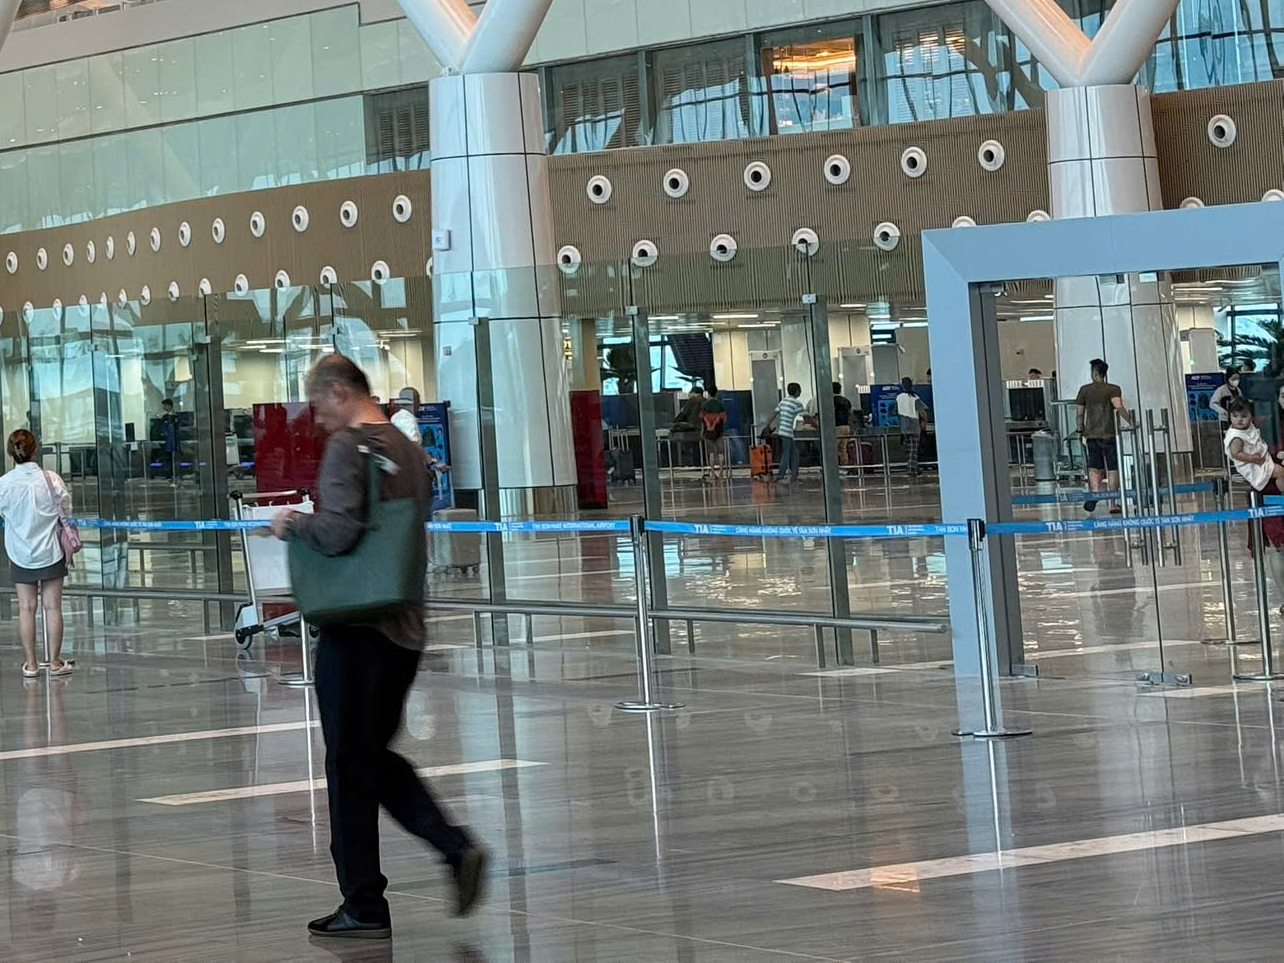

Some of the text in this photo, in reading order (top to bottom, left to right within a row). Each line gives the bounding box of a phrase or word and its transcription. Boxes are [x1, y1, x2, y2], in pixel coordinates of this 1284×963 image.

[1248, 509, 1263, 517] TIA
[494, 523, 507, 531] TIA
[694, 524, 708, 534] TIA
[886, 526, 903, 535] TIA
[1046, 522, 1063, 531] TIA
